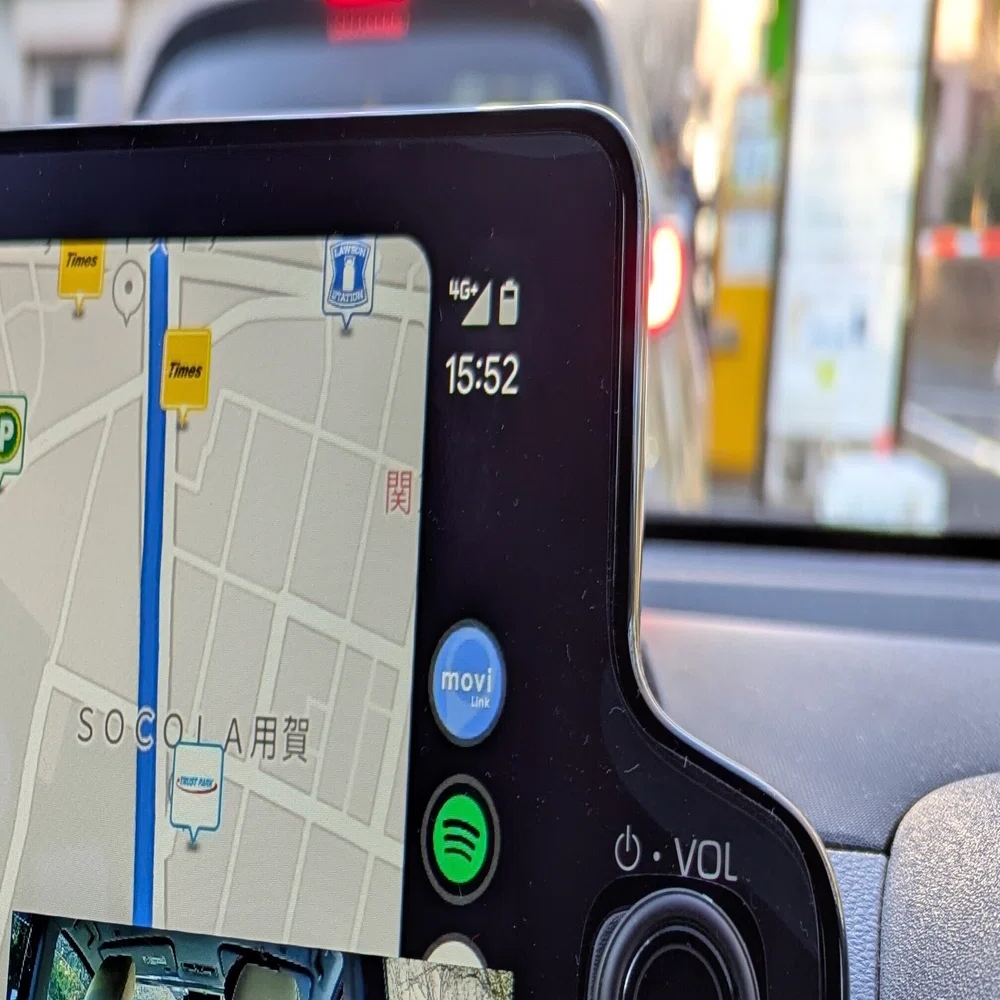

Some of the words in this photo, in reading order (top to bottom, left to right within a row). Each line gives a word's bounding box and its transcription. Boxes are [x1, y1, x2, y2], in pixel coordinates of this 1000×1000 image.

[66, 251, 98, 269] Times
[449, 277, 478, 300] 4G+
[168, 361, 203, 379] Times
[446, 353, 520, 396] 15:52
[385, 469, 413, 516] 関
[441, 667, 492, 693] movi
[471, 696, 491, 709] Link
[674, 837, 738, 882] VOL
